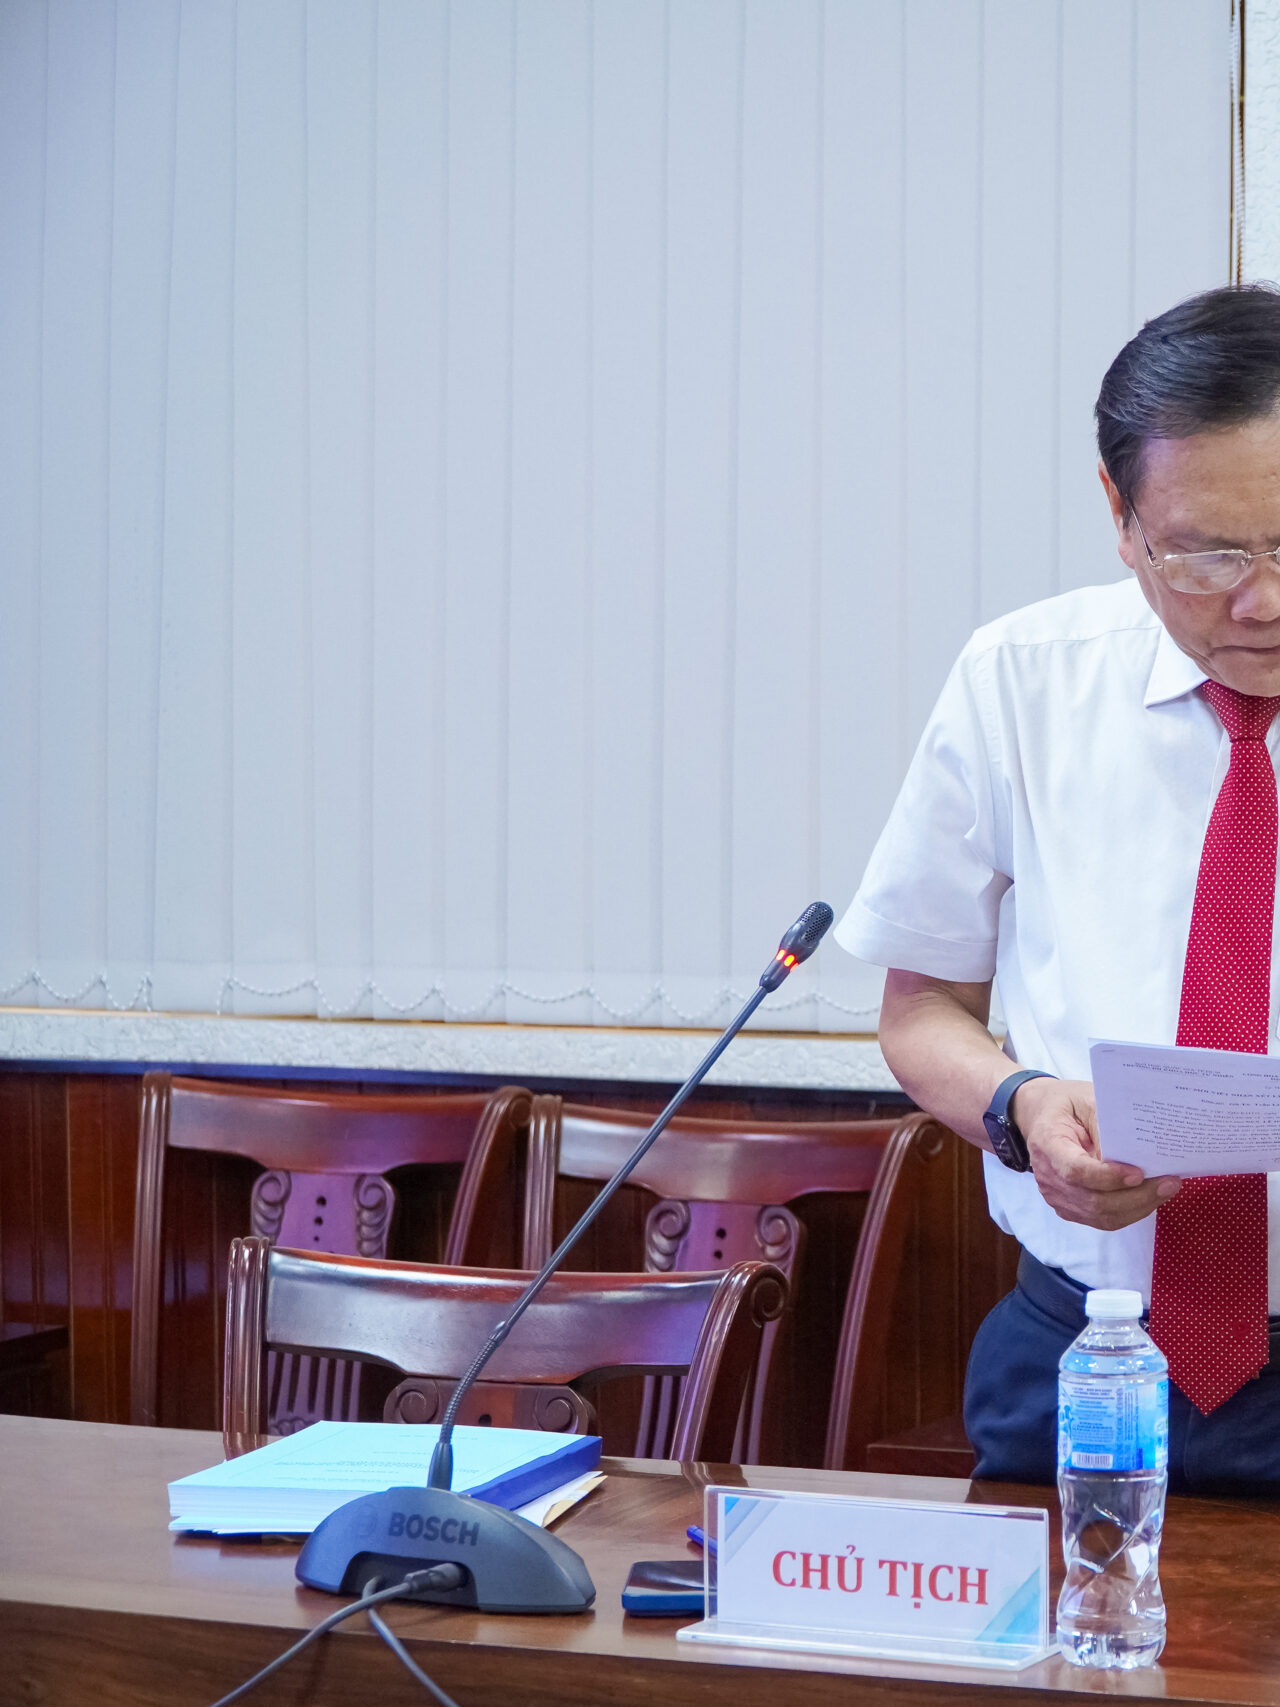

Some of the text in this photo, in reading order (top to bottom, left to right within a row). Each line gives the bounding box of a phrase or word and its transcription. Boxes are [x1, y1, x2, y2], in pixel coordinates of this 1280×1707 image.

[388, 1512, 480, 1546] BOSCH
[772, 1544, 989, 1609] CHỦ TỊCH
